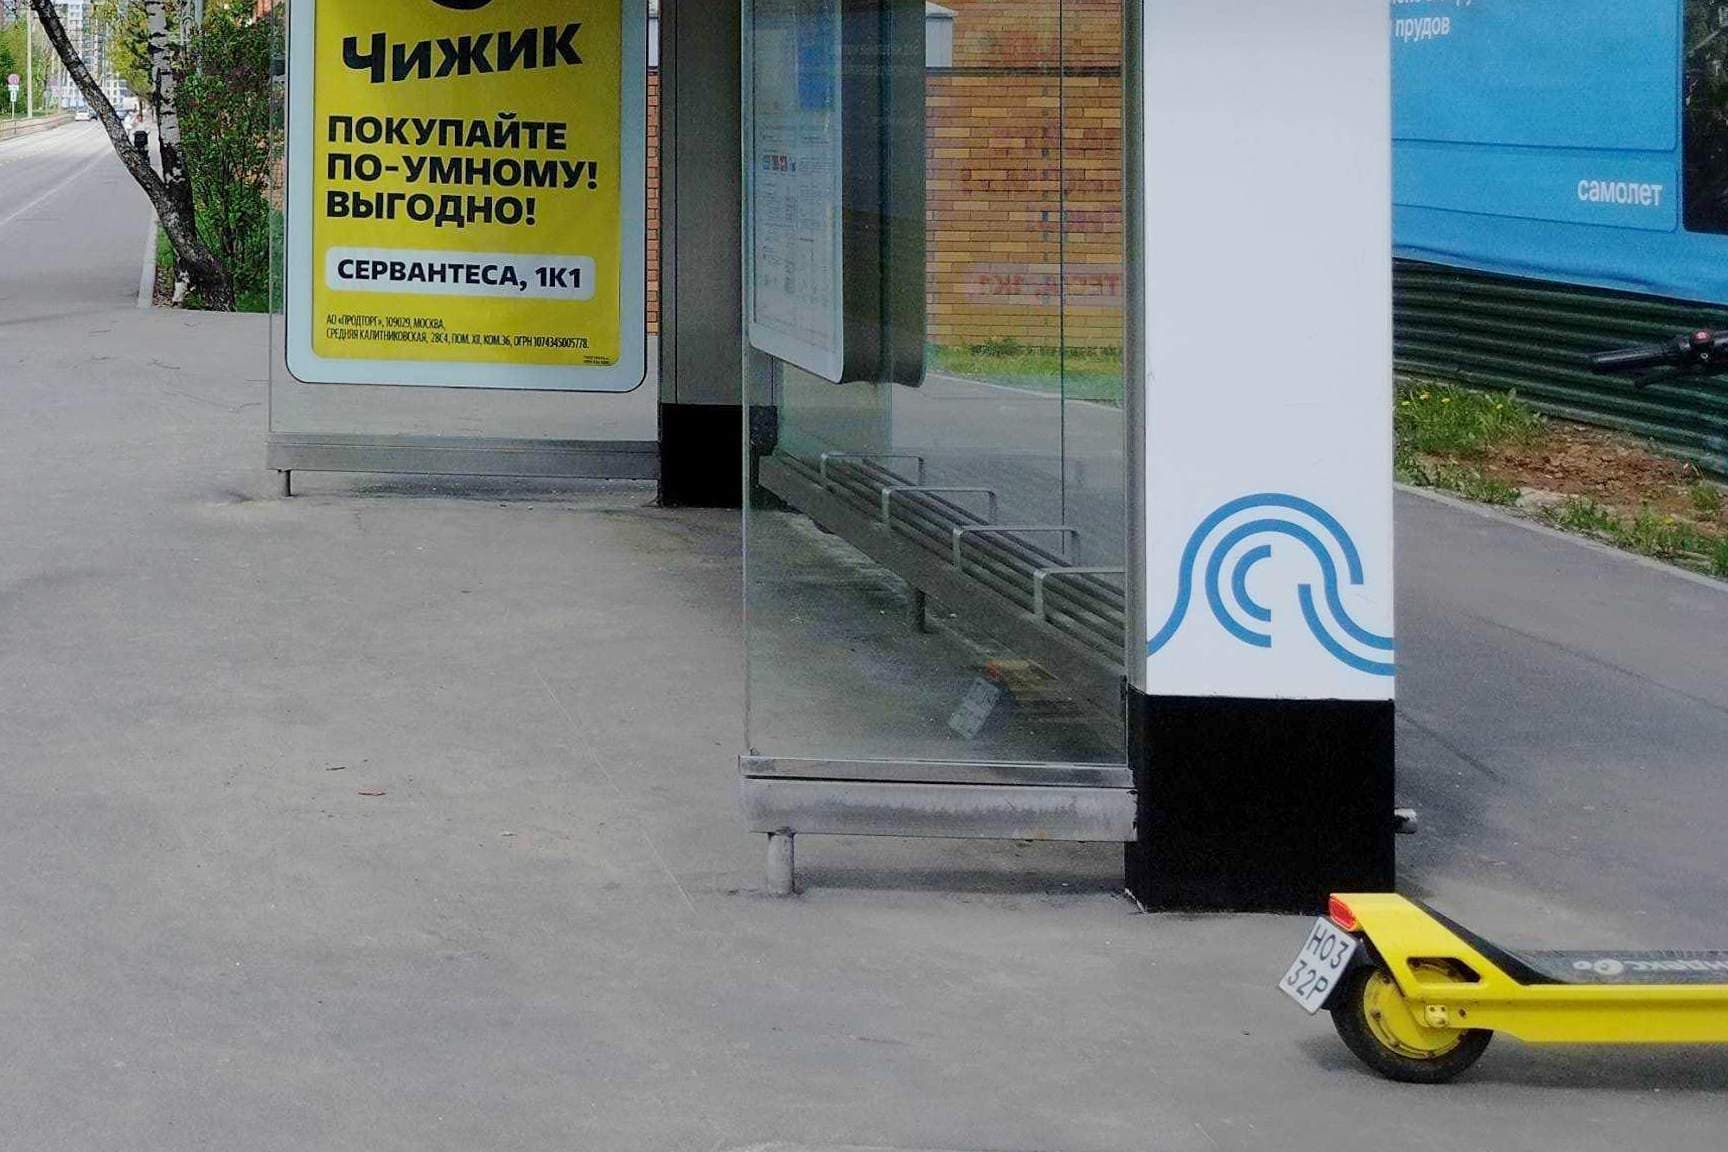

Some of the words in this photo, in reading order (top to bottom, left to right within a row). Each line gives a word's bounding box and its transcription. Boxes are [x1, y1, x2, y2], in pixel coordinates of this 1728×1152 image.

[1395, 17, 1451, 43] прудов
[328, 112, 567, 150] ПОКУПАЙТЕ
[327, 153, 598, 189] ПО-УМНОМУ!
[327, 190, 536, 228] ВЫГОДНО!
[1577, 179, 1663, 206] самолет
[337, 259, 527, 291] СЕРВАНТЕСА,
[535, 266, 581, 288] 1К1
